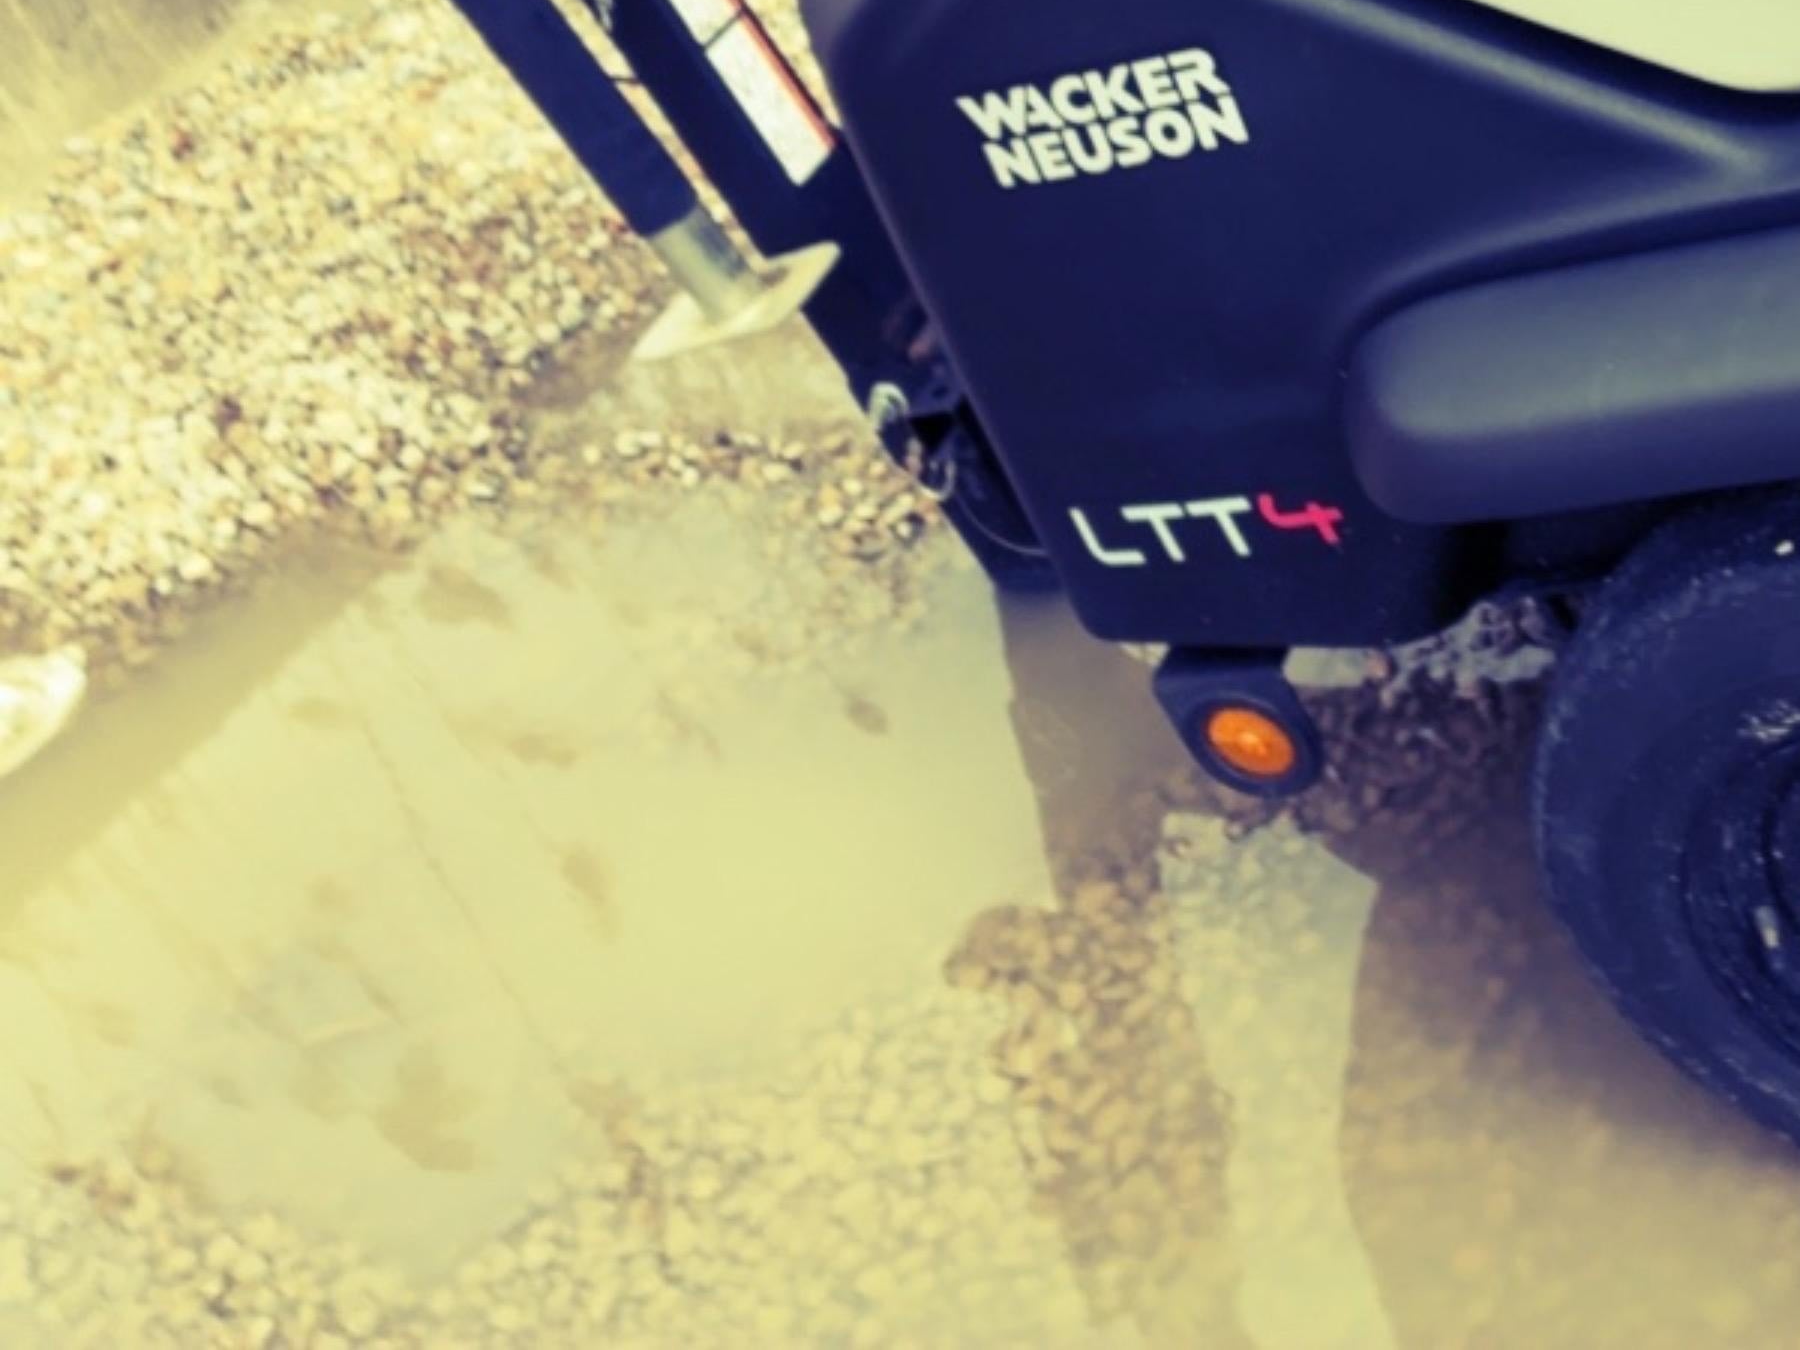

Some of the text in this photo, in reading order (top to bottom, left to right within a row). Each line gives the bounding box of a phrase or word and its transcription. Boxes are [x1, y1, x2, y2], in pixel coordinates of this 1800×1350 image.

[955, 47, 1232, 141] WACKER
[983, 94, 1249, 189] NEUSON
[1068, 493, 1344, 566] LTT4
